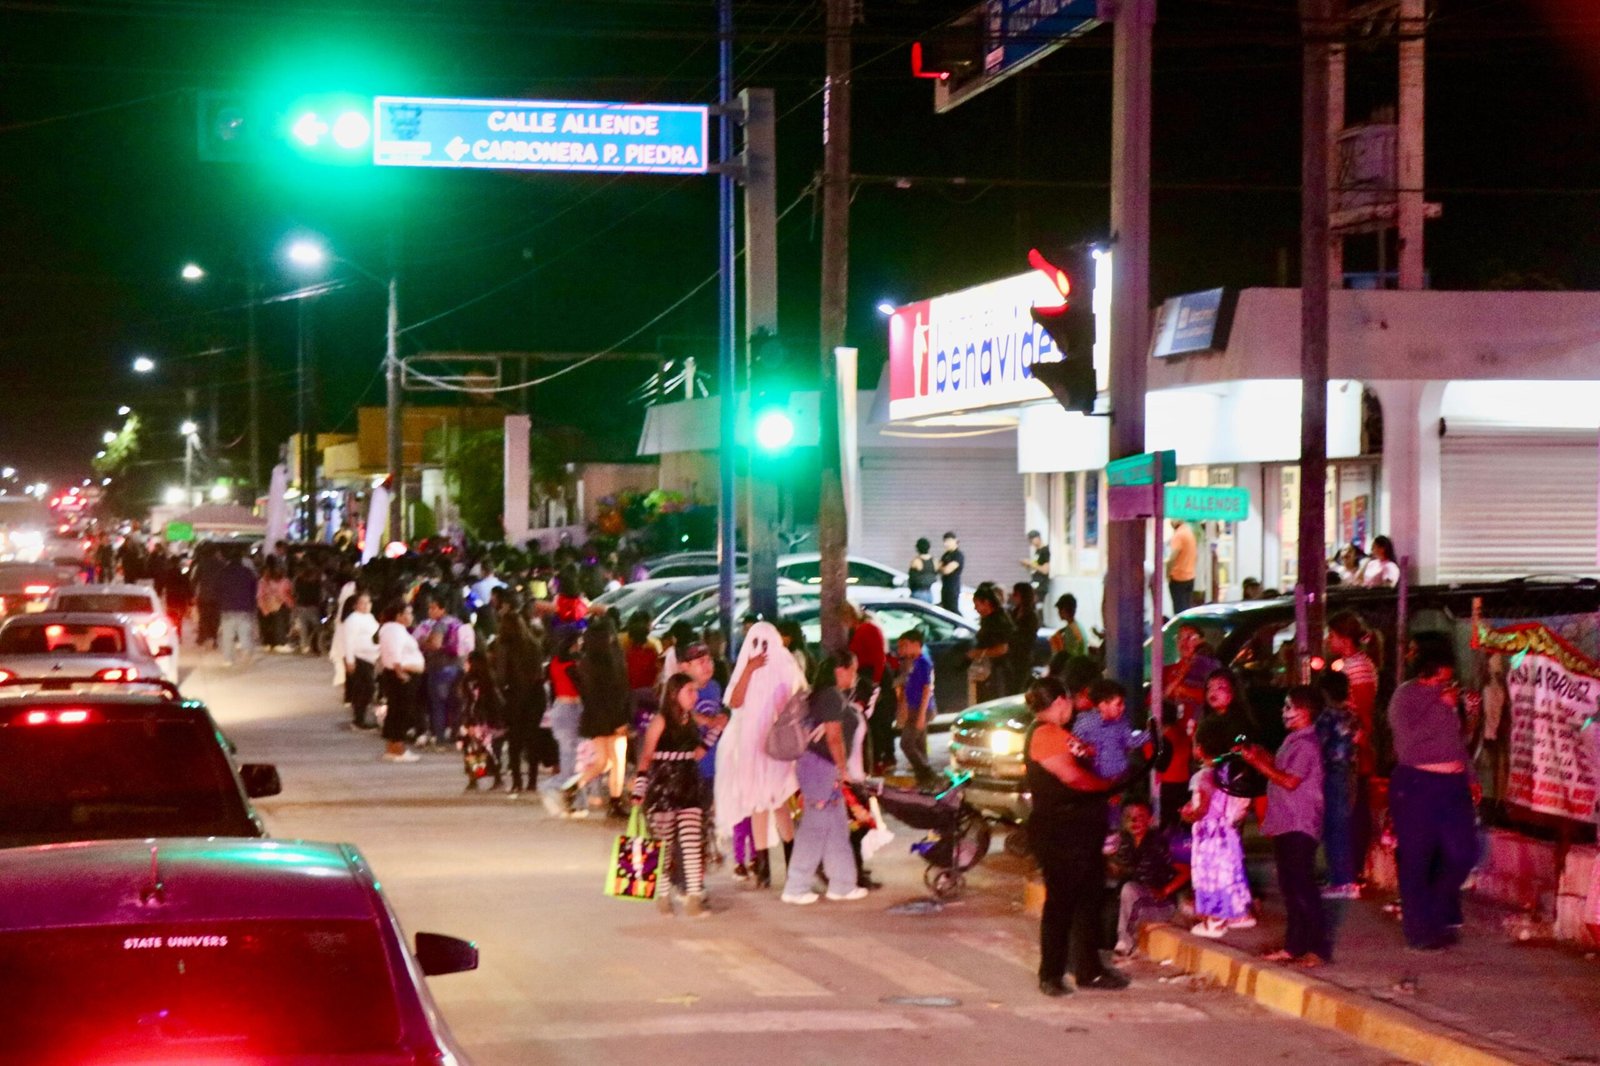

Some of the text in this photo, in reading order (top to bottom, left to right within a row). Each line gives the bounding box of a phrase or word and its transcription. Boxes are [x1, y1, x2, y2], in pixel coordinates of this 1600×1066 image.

[487, 112, 659, 136] CALLE ALLENDE
[472, 141, 698, 166] CARBONERA P. PIEDRA
[936, 301, 1068, 393] benavide
[1185, 495, 1240, 512] ALLENDE
[123, 935, 228, 950] STATE UNIVERS
